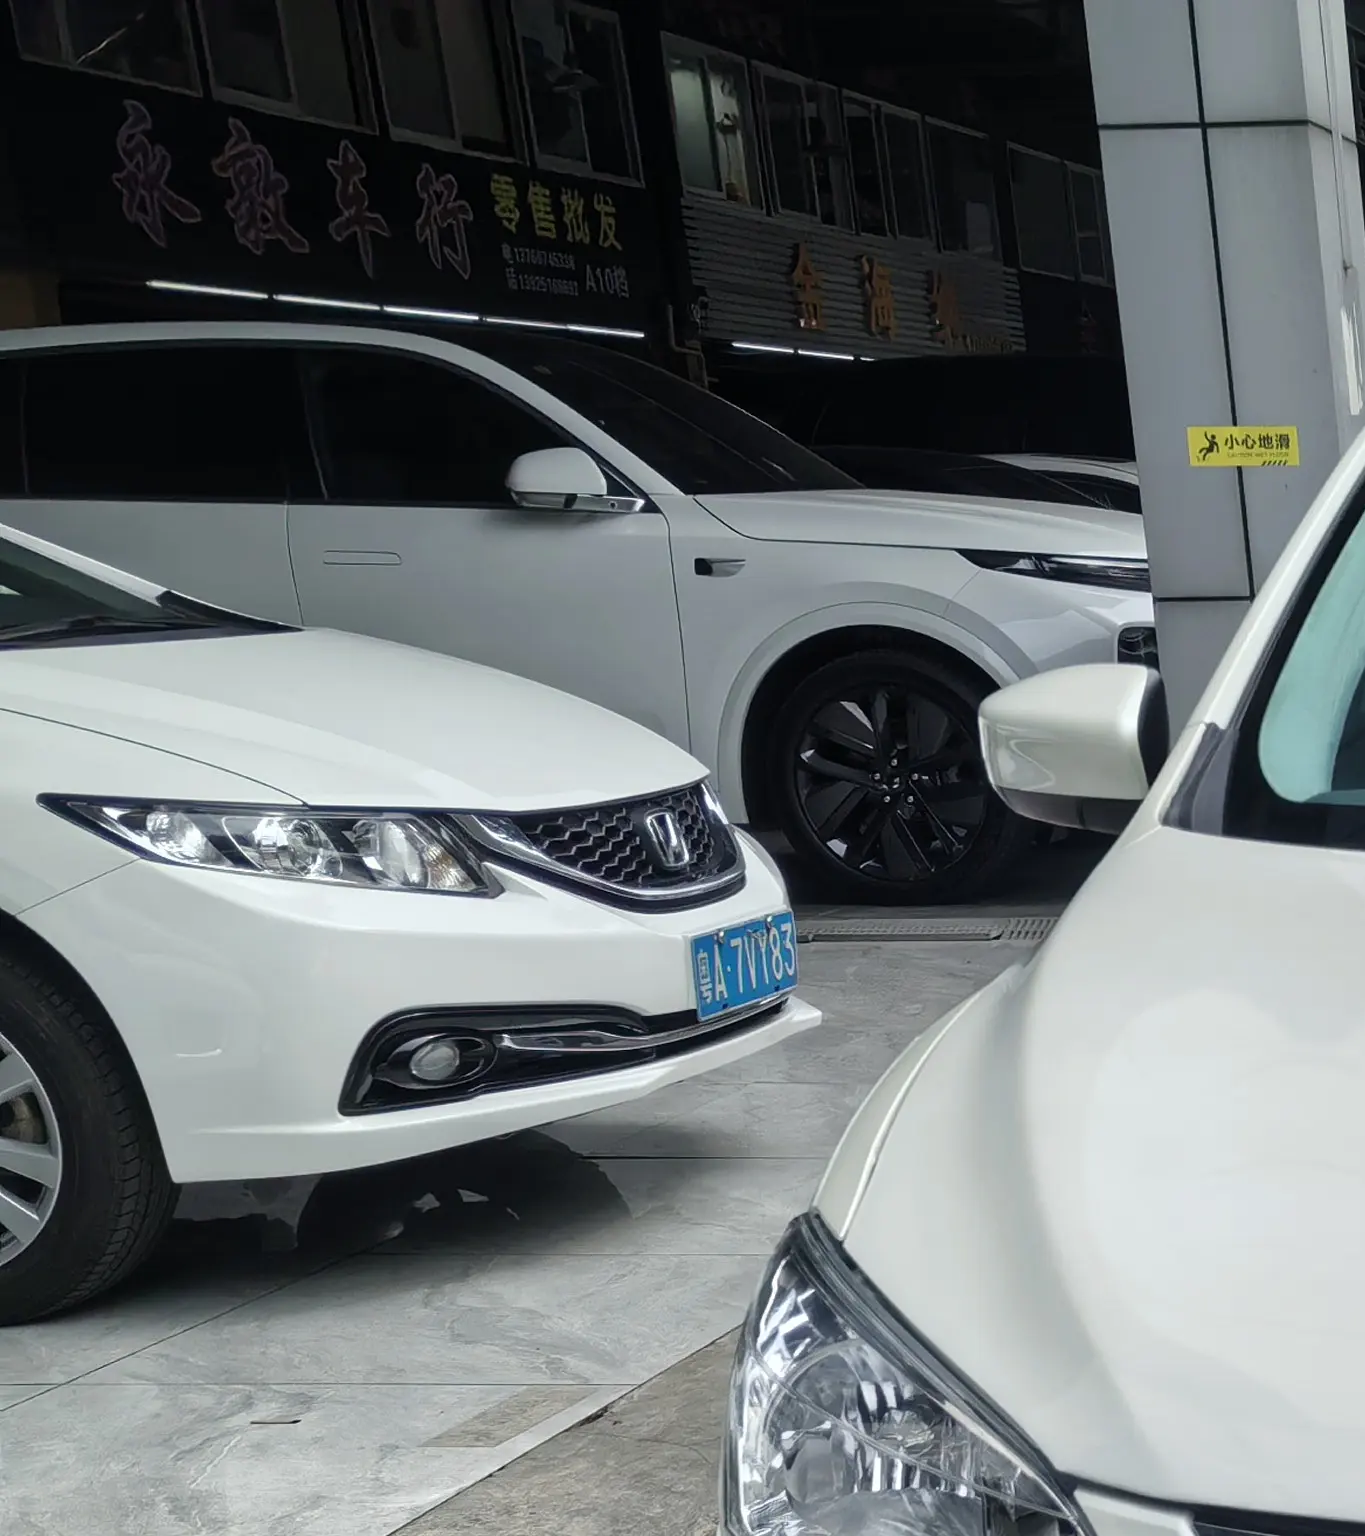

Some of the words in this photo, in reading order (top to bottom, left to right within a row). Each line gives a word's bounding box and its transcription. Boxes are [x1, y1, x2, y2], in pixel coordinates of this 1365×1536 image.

[489, 172, 624, 252] 零售批发
[1224, 433, 1291, 450] 小心地滑
